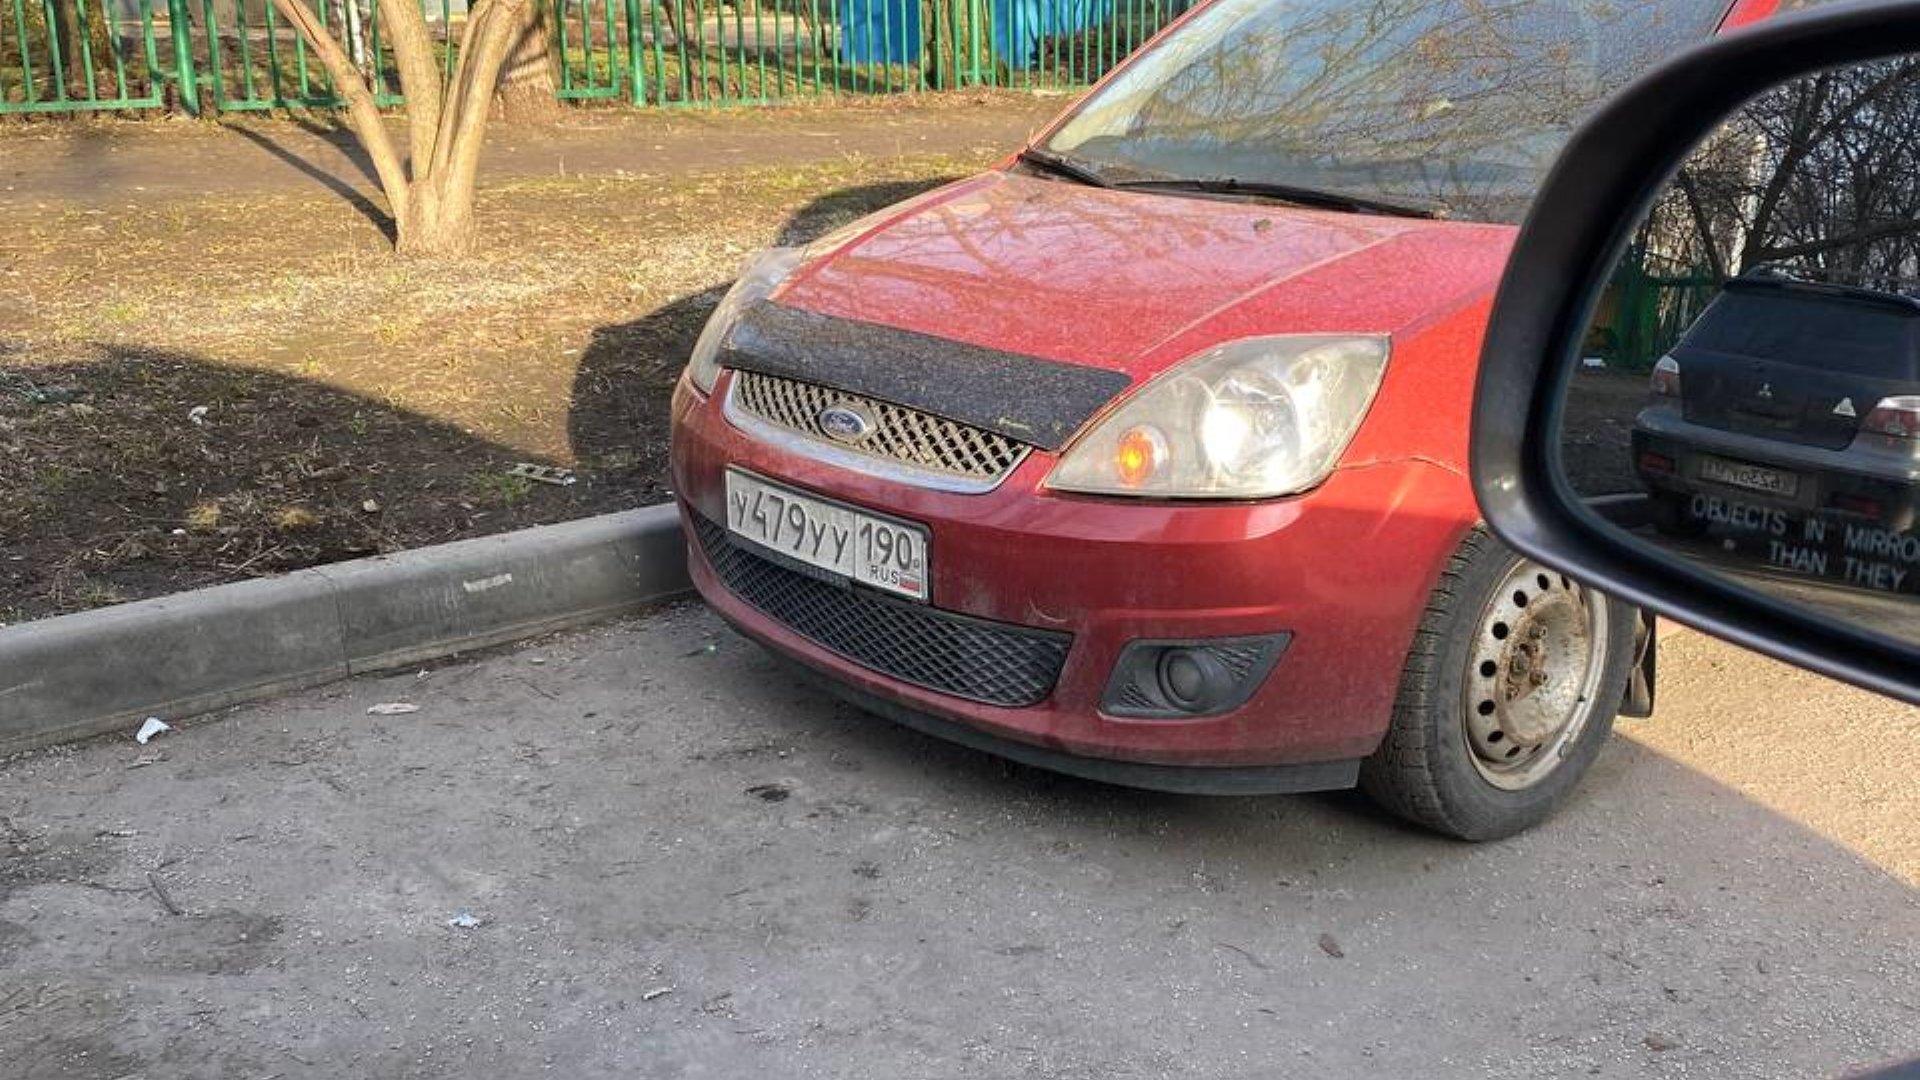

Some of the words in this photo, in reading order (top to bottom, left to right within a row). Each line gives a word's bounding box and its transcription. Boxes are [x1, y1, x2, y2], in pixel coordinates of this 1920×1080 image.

[859, 522, 912, 570] 190
[1692, 495, 1786, 535] OBJECTS
[1804, 517, 1826, 543] IN
[1844, 523, 1920, 562] MIRRO
[869, 564, 898, 584] RUS
[1769, 539, 1827, 576] THAN
[1844, 557, 1907, 591] THEY
